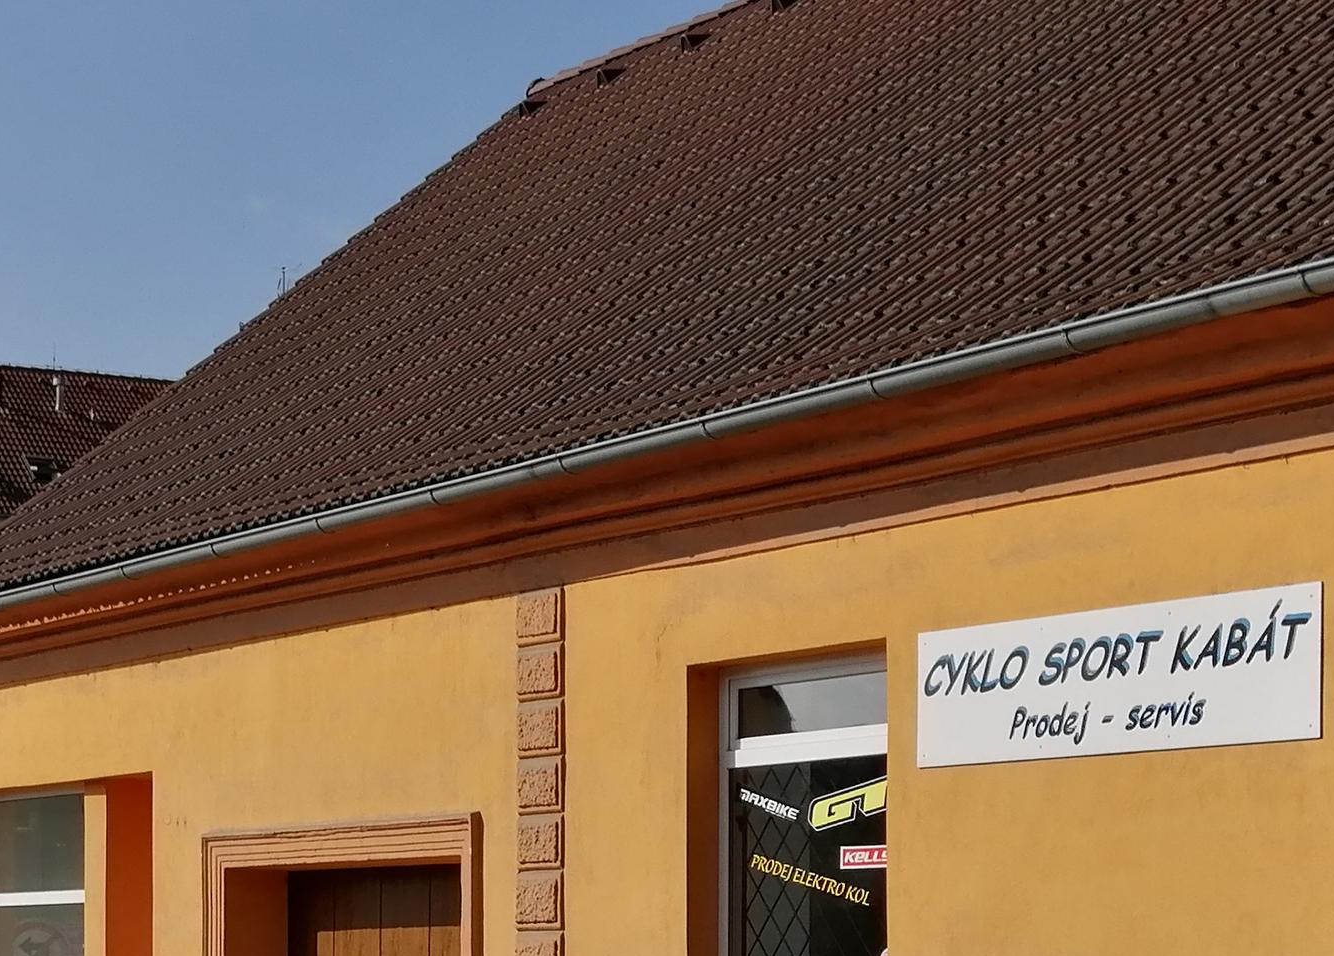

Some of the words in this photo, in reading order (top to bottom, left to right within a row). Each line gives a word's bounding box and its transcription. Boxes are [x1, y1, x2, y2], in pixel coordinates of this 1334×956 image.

[923, 645, 1030, 697] CYKLO
[1038, 630, 1164, 687] SPORT
[1170, 598, 1313, 675] KABÁT
[1009, 701, 1091, 745] Prodej
[1125, 691, 1207, 732] servis
[751, 854, 794, 881] PRODEJ
[793, 868, 845, 896] ELEKTRO
[845, 886, 870, 906] KOL
